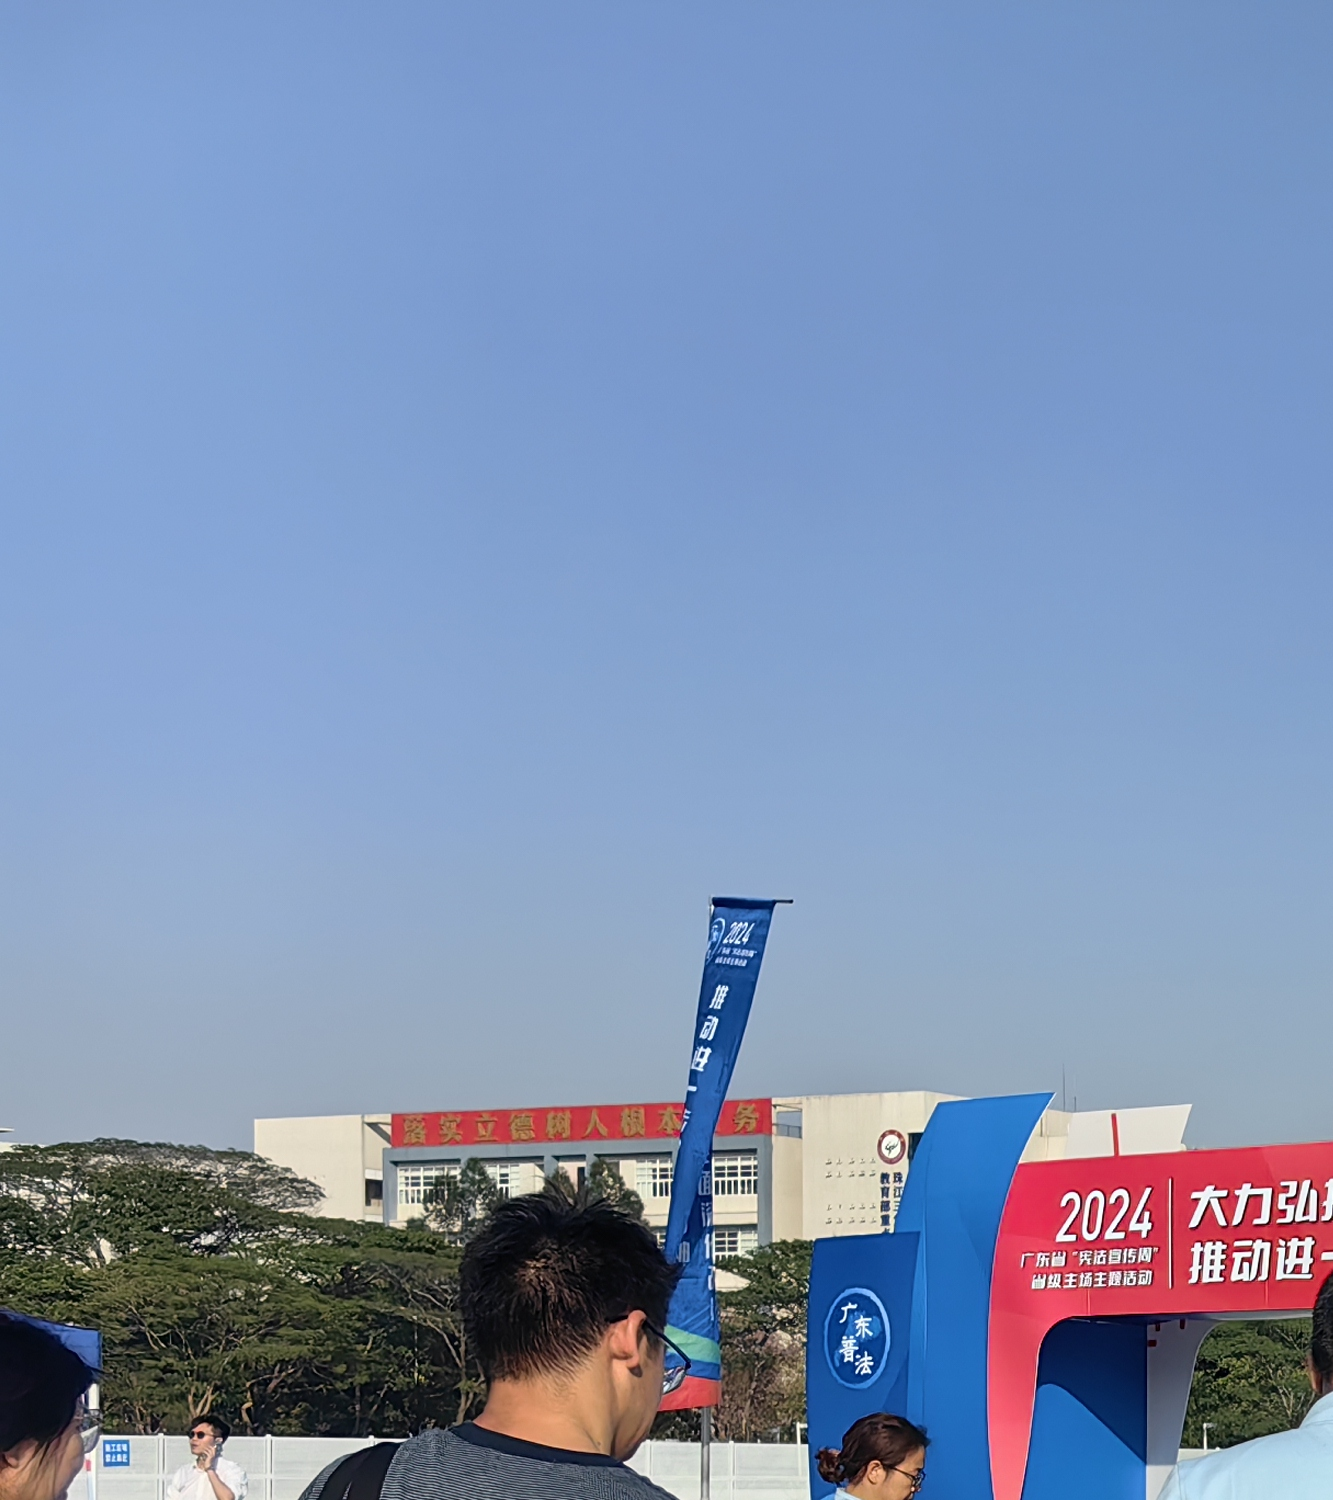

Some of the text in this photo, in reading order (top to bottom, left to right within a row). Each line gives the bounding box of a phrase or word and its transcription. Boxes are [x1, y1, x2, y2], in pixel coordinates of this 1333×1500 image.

[722, 922, 756, 945] 2024
[403, 1102, 760, 1145] 落实立德树人根本务
[1055, 1187, 1153, 1243] 2024
[1031, 1270, 1153, 1290] 省级主场主题活动
[838, 1301, 874, 1377] 广东普法
